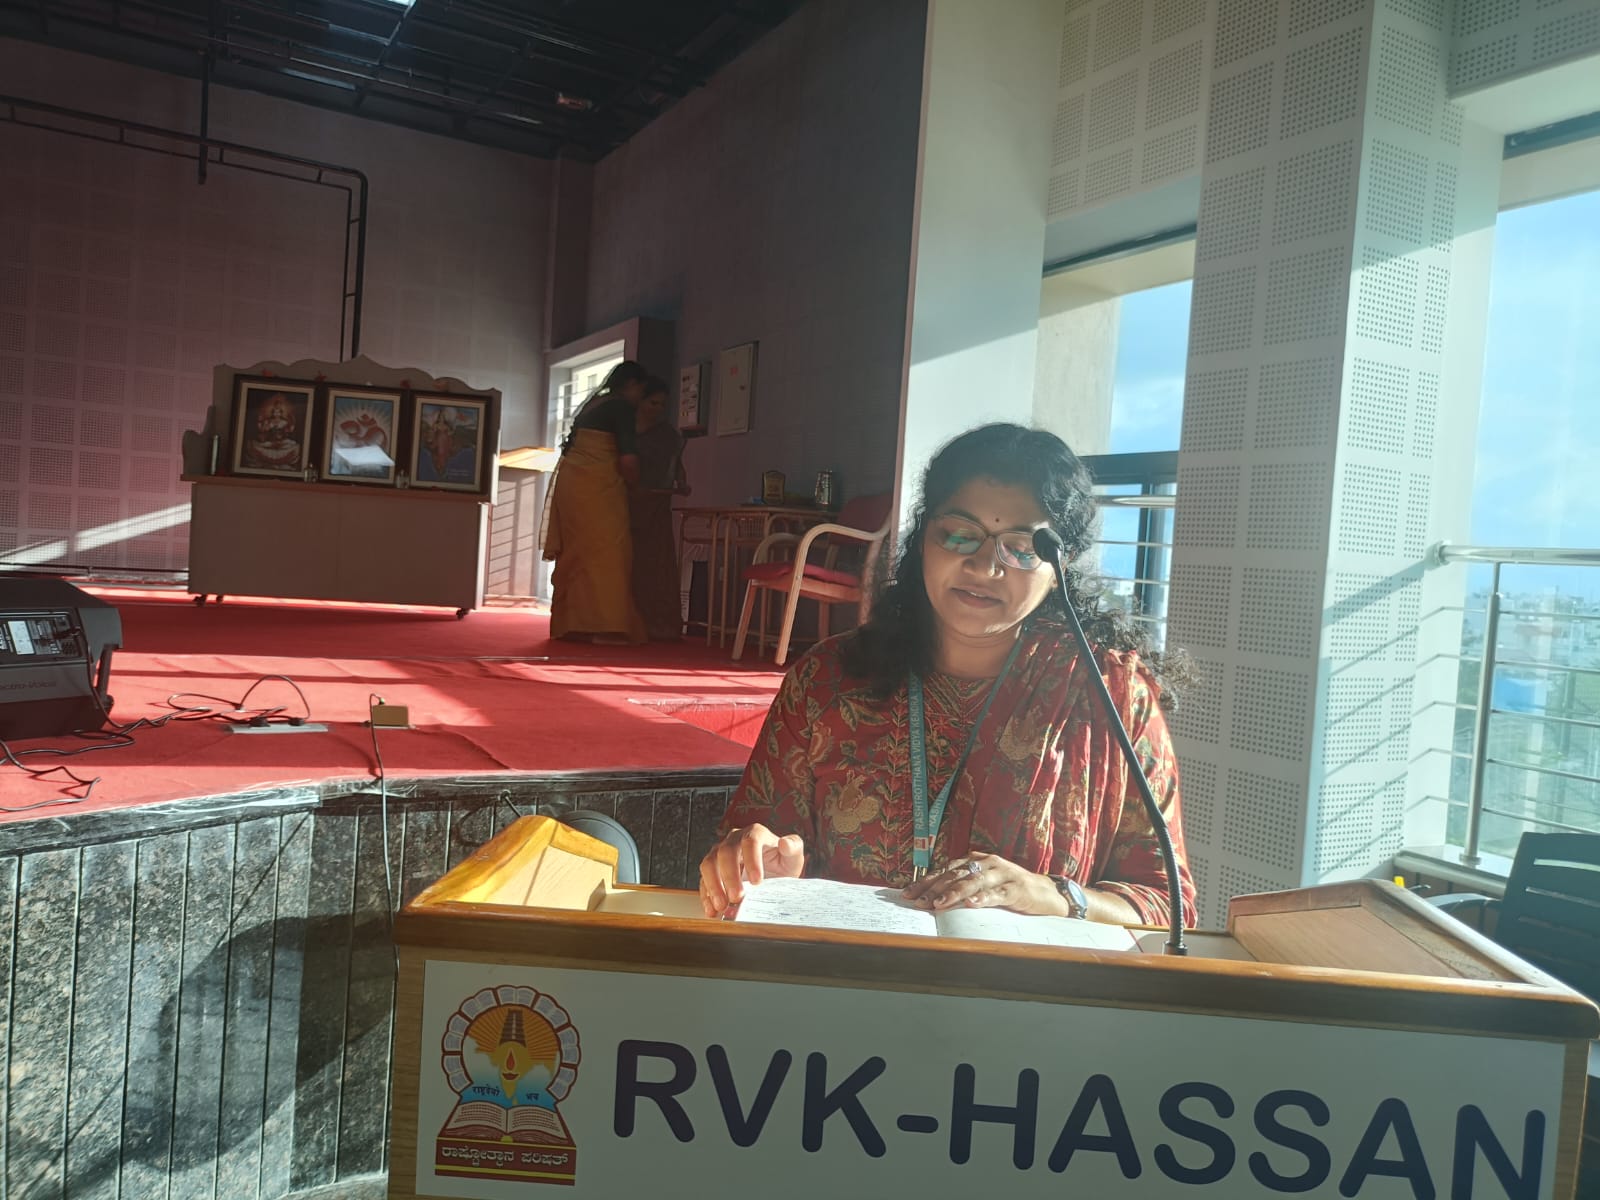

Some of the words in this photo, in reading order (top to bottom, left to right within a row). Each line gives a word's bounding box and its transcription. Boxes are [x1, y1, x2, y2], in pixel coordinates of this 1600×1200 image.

[911, 695, 920, 728] KENDRA
[911, 729, 921, 753] VIDYA
[912, 754, 924, 829] RASHTROTTHANA
[614, 1039, 1546, 1200] RVK-HASSAN
[521, 1151, 568, 1166] ಪರಿಷತ್
